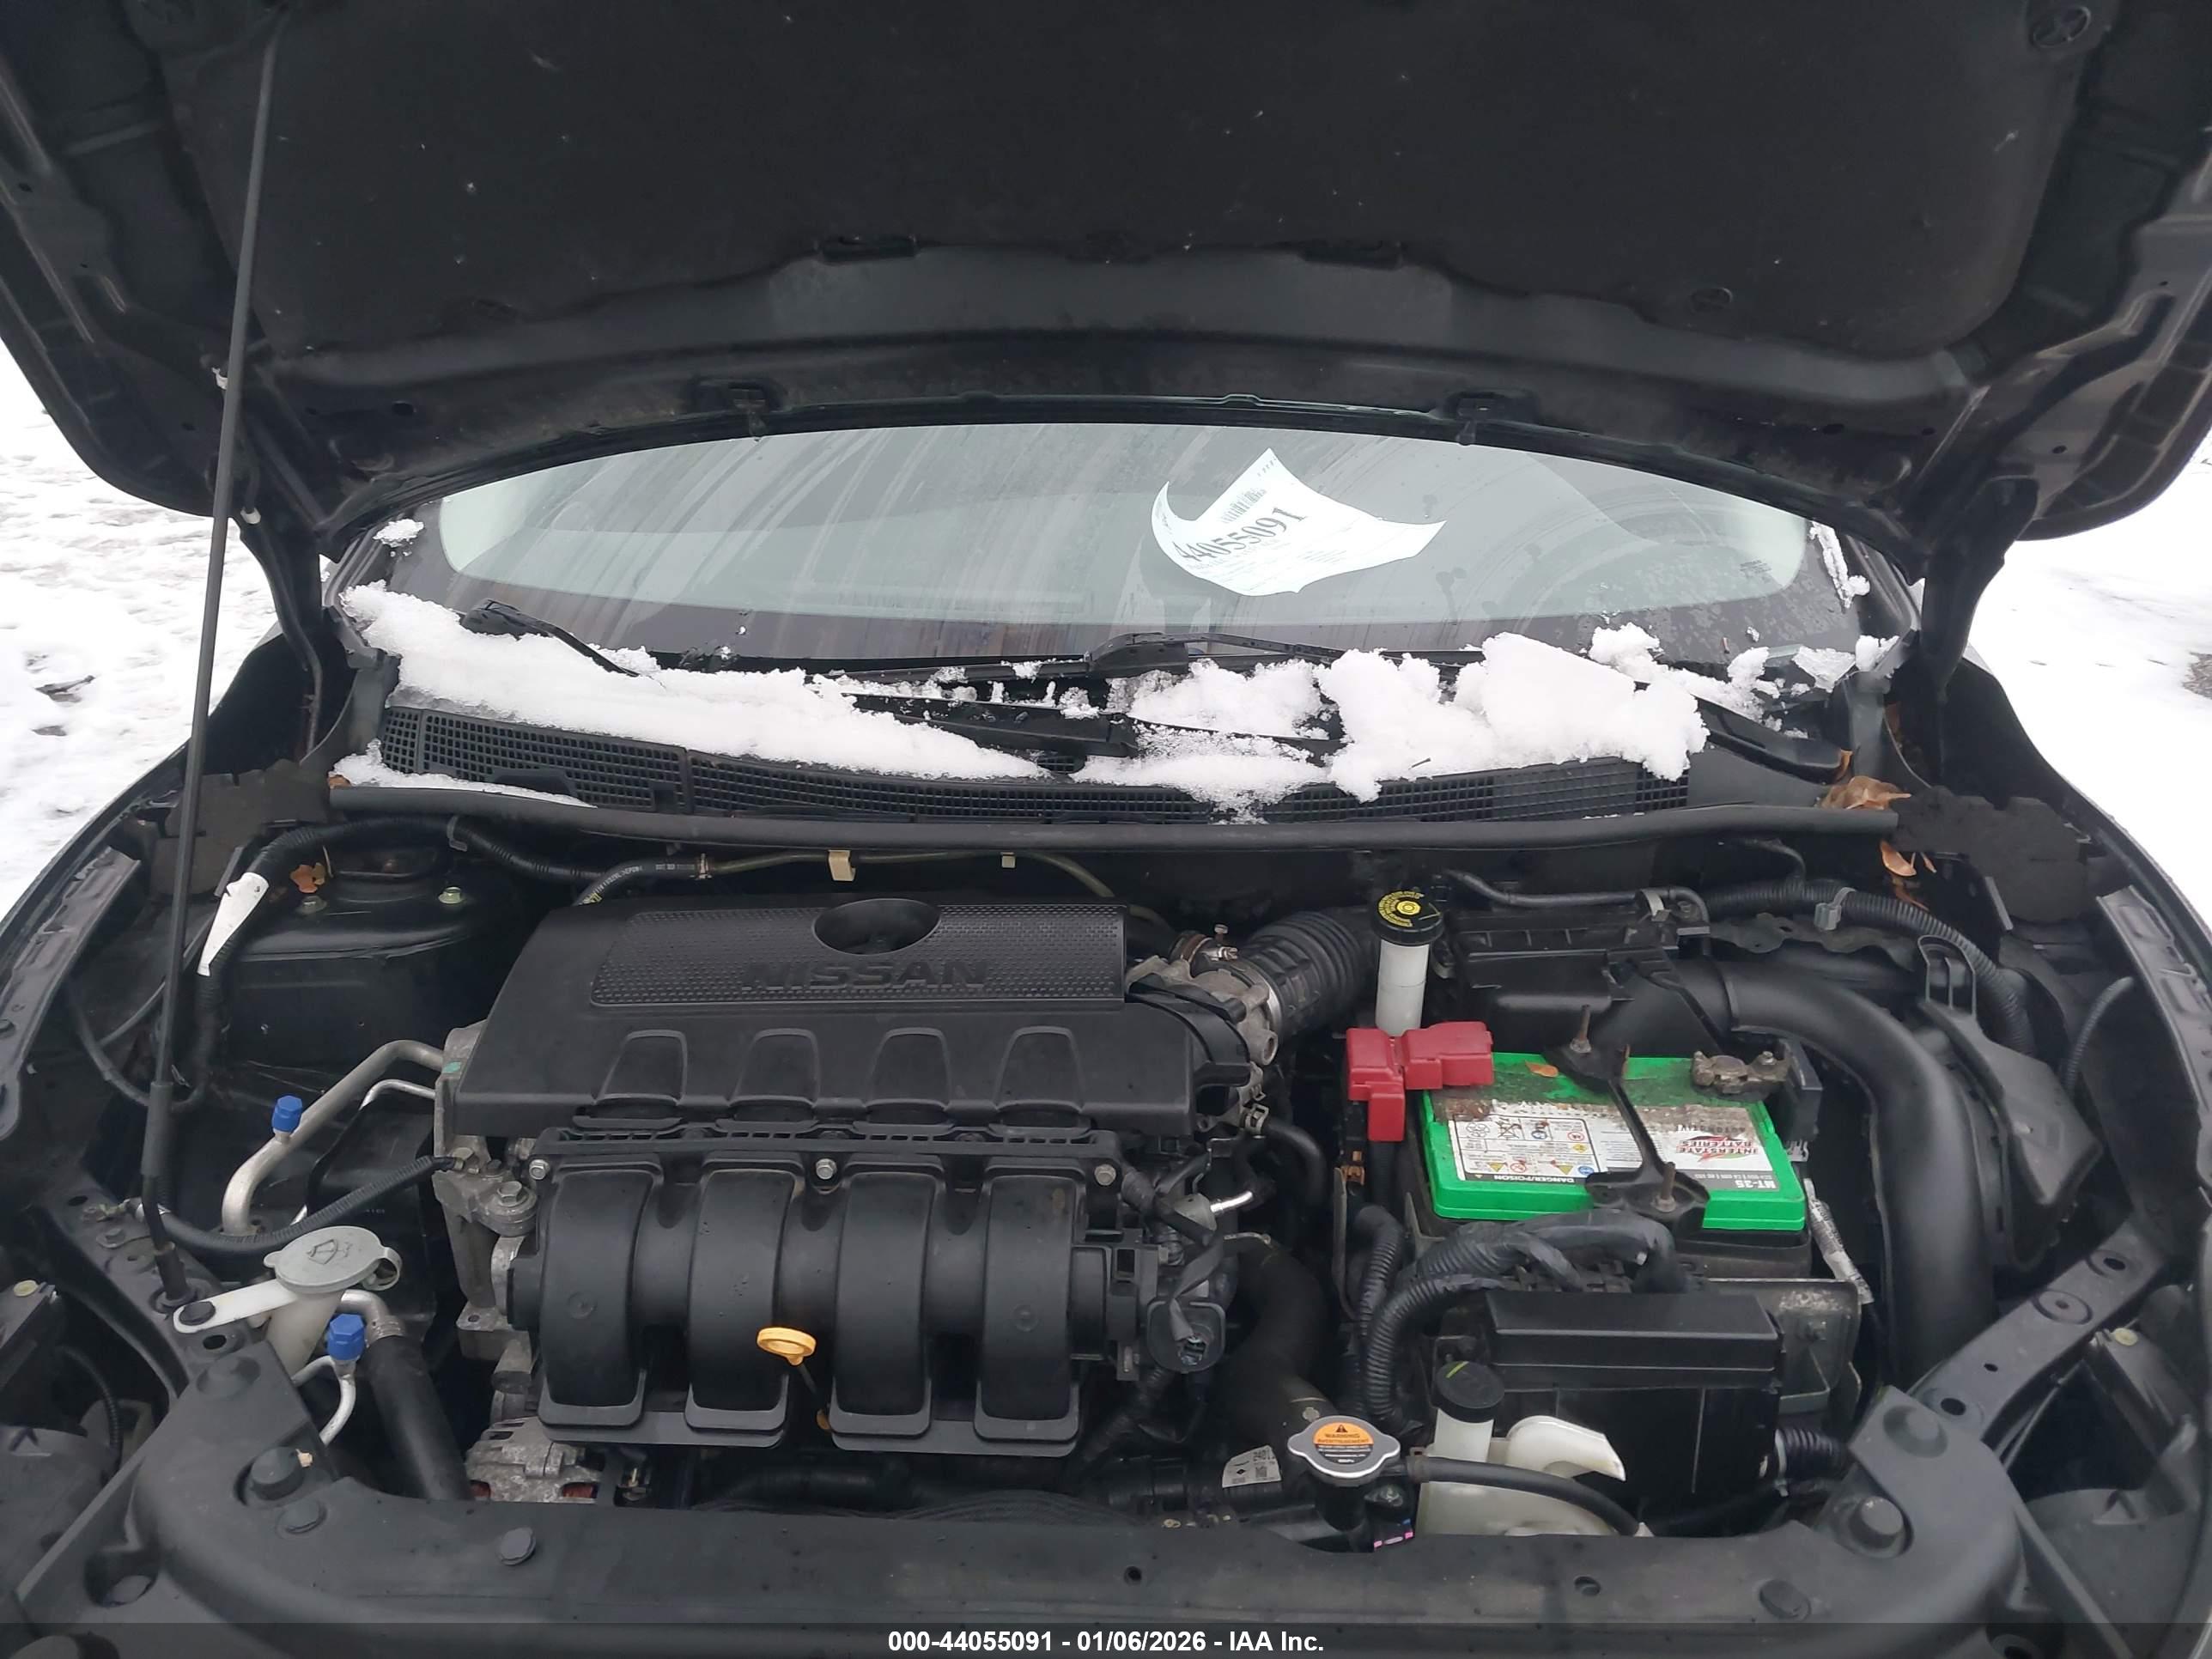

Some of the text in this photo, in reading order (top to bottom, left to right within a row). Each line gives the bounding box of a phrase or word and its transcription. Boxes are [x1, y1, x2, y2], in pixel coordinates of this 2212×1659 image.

[1172, 507, 1308, 562] 44055091
[742, 961, 987, 990] NISSAN
[1493, 1175, 1575, 1183] DANGER/POISON
[1736, 1180, 1777, 1189] MT-35
